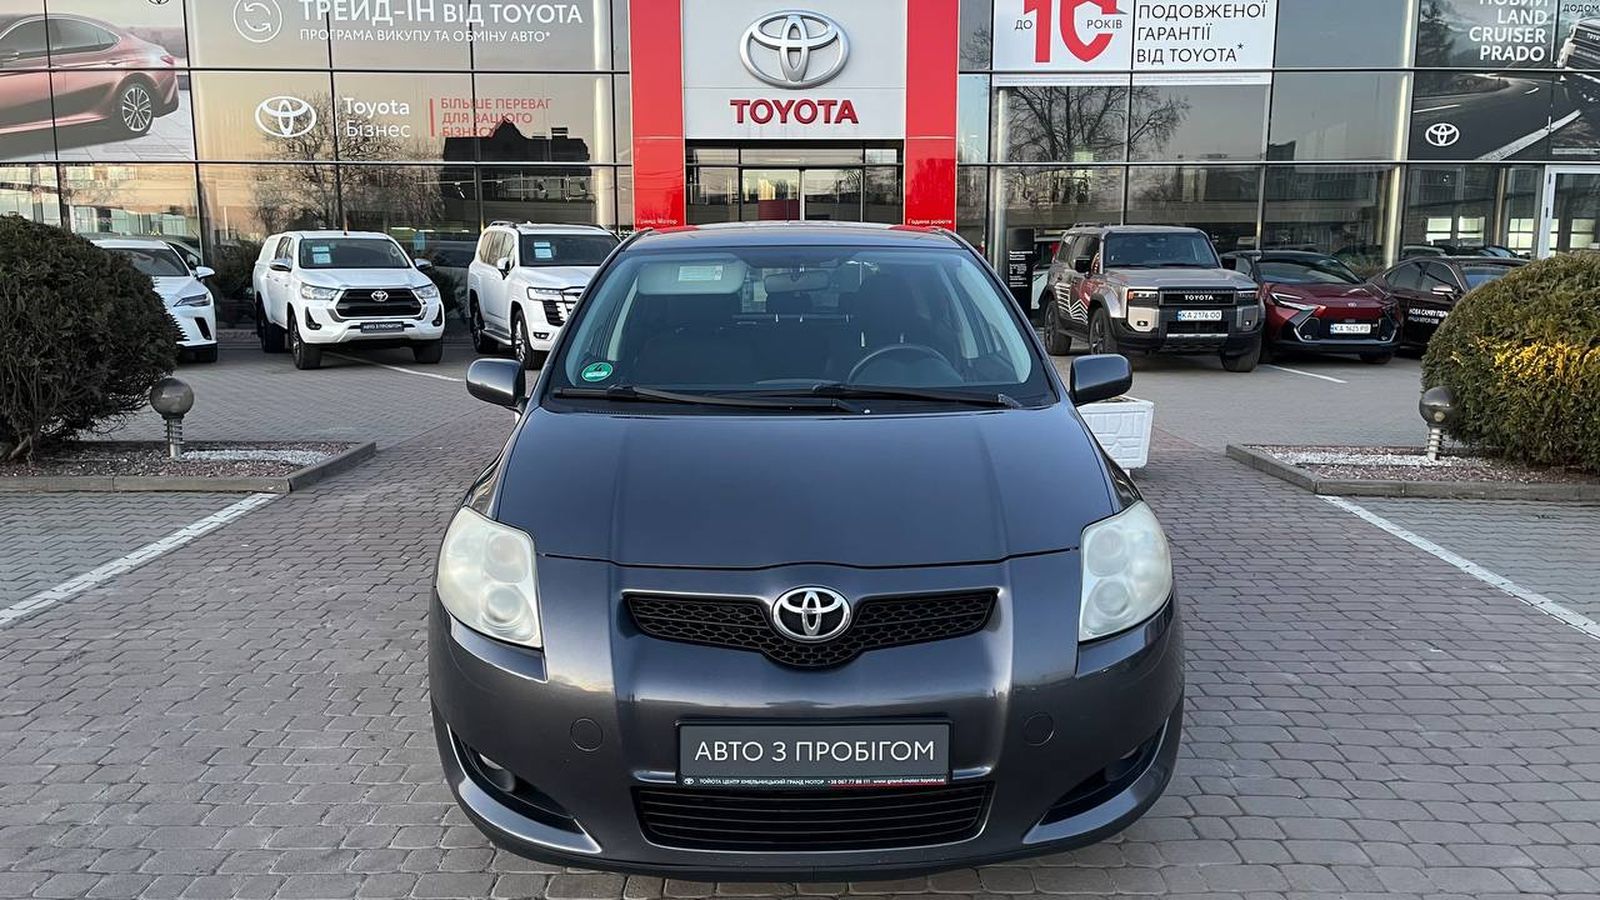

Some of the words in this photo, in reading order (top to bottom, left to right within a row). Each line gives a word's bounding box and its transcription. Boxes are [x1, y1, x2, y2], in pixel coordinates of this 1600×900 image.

[300, 0, 435, 26] ТРЕЙД-ІН
[443, 3, 484, 27] ВІД
[490, 4, 583, 24] TOYOTA
[1138, 0, 1268, 20] ПОДОВЖЕНОЇ
[1497, 9, 1548, 25] LAND
[1014, 19, 1033, 31] ДО
[1086, 19, 1123, 30] РОКІВ
[1137, 23, 1213, 41] ГАРАНТІЇ
[300, 28, 374, 41] ПРОГРАМА
[377, 29, 431, 42] ВИКУПУ
[433, 31, 450, 42] ТА
[453, 31, 507, 42] ОБМІНУ
[1469, 26, 1546, 43] CRUISER
[1137, 49, 1165, 65] ВІД
[1479, 45, 1545, 61] PRADO
[343, 97, 410, 118] Toyota
[441, 98, 492, 109] БІЛЬШЕ
[495, 98, 552, 109] ПЕРЕВАГ
[730, 99, 859, 125] TOYOTA
[442, 113, 469, 124] ДЛЯ
[346, 120, 411, 138] Бізнес
[694, 741, 764, 762] АВТО
[772, 741, 787, 761] З
[796, 741, 935, 762] ПРОБІГОМ
